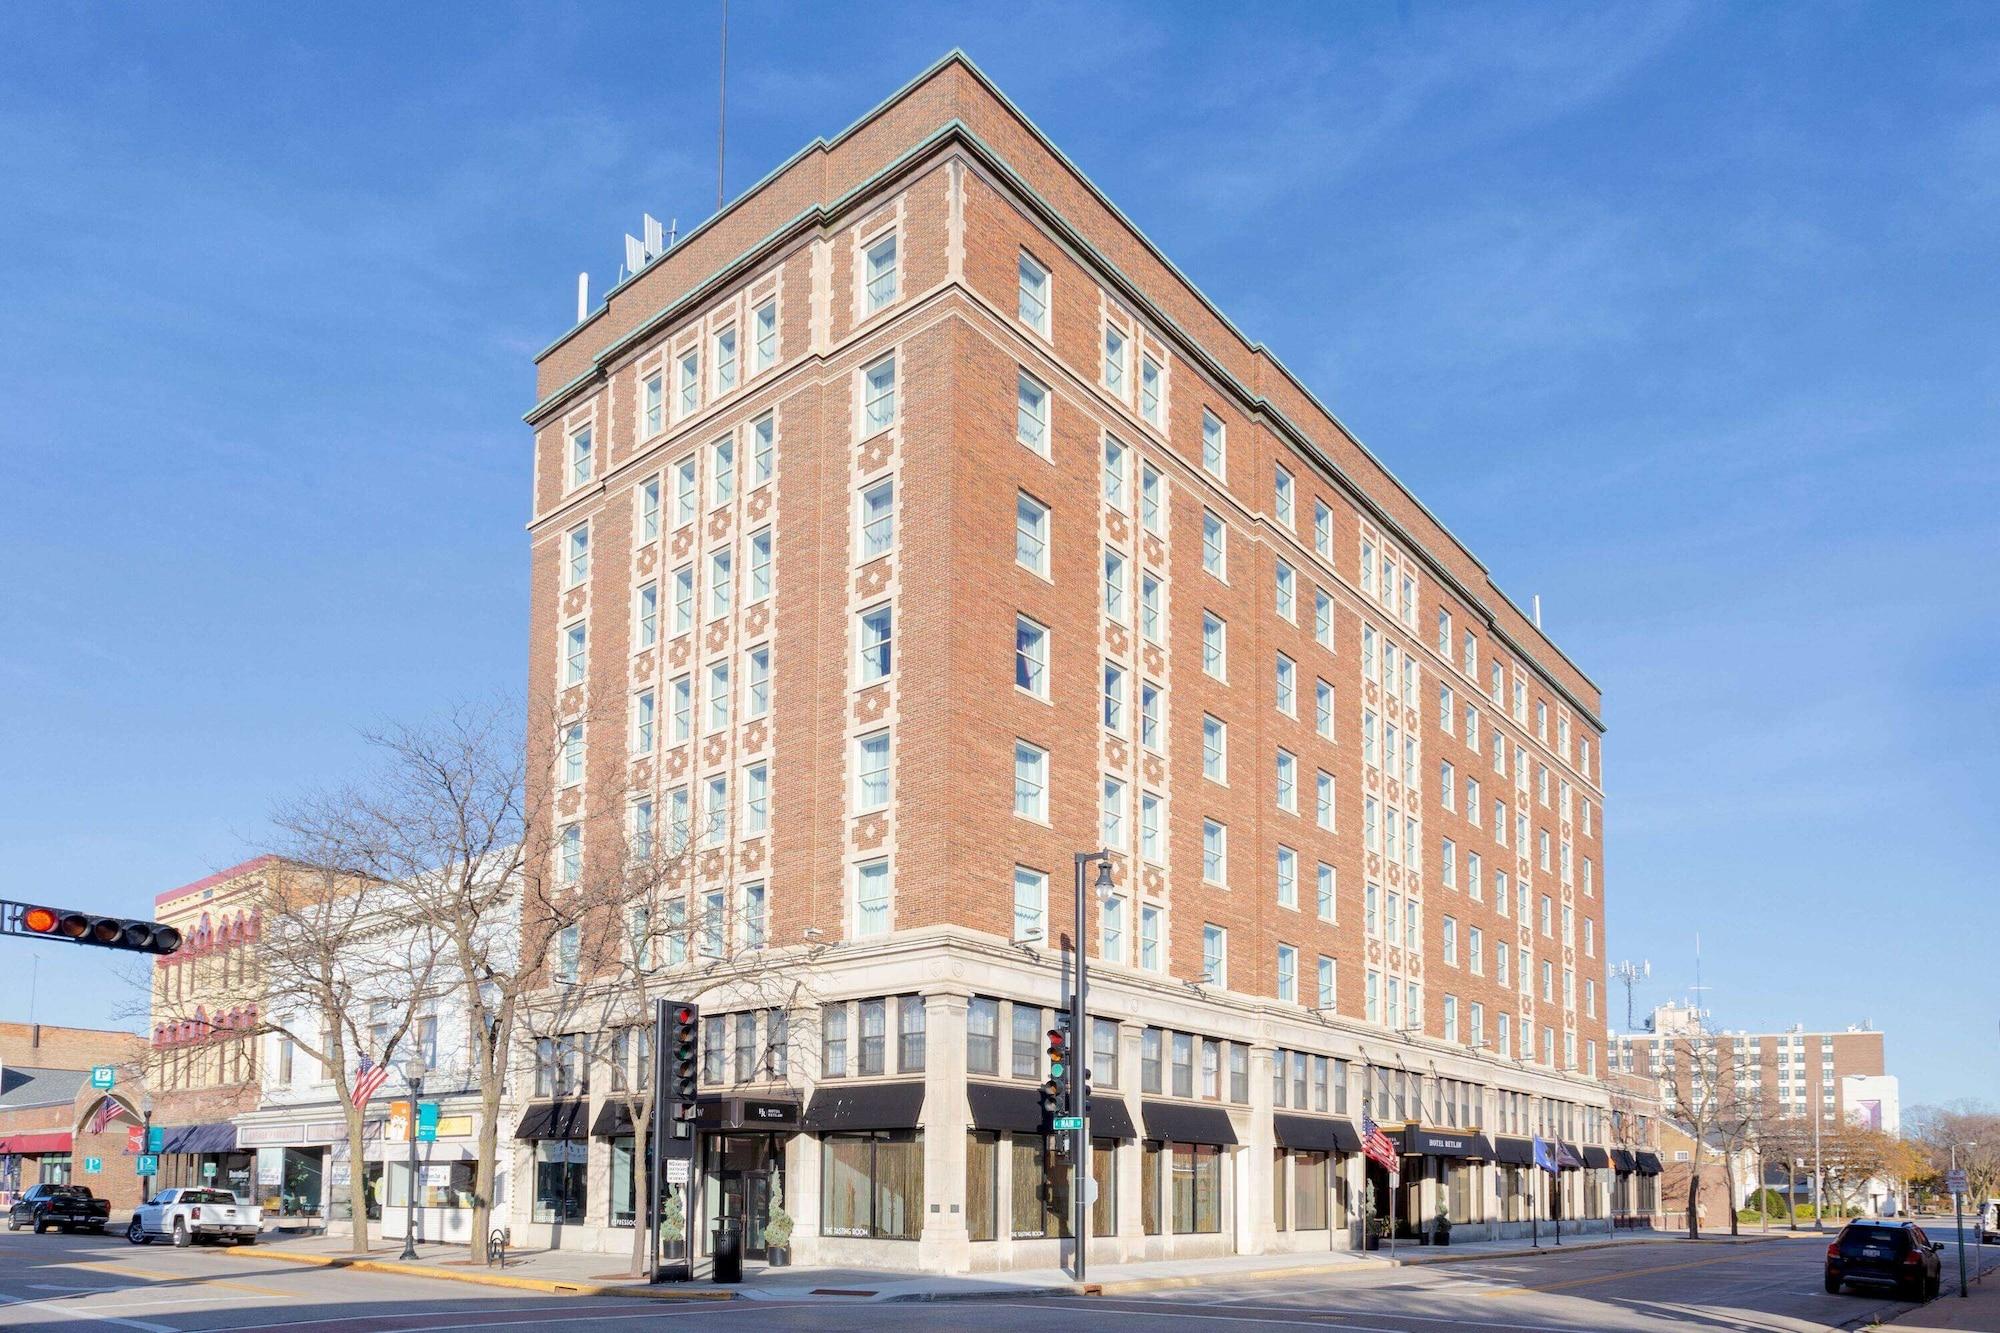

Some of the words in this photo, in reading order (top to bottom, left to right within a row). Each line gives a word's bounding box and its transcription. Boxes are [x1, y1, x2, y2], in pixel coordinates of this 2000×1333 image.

[1429, 1139, 1444, 1147] HOTEL
[1445, 1140, 1462, 1148] RETLAW
[851, 1228, 868, 1237] ROOM
